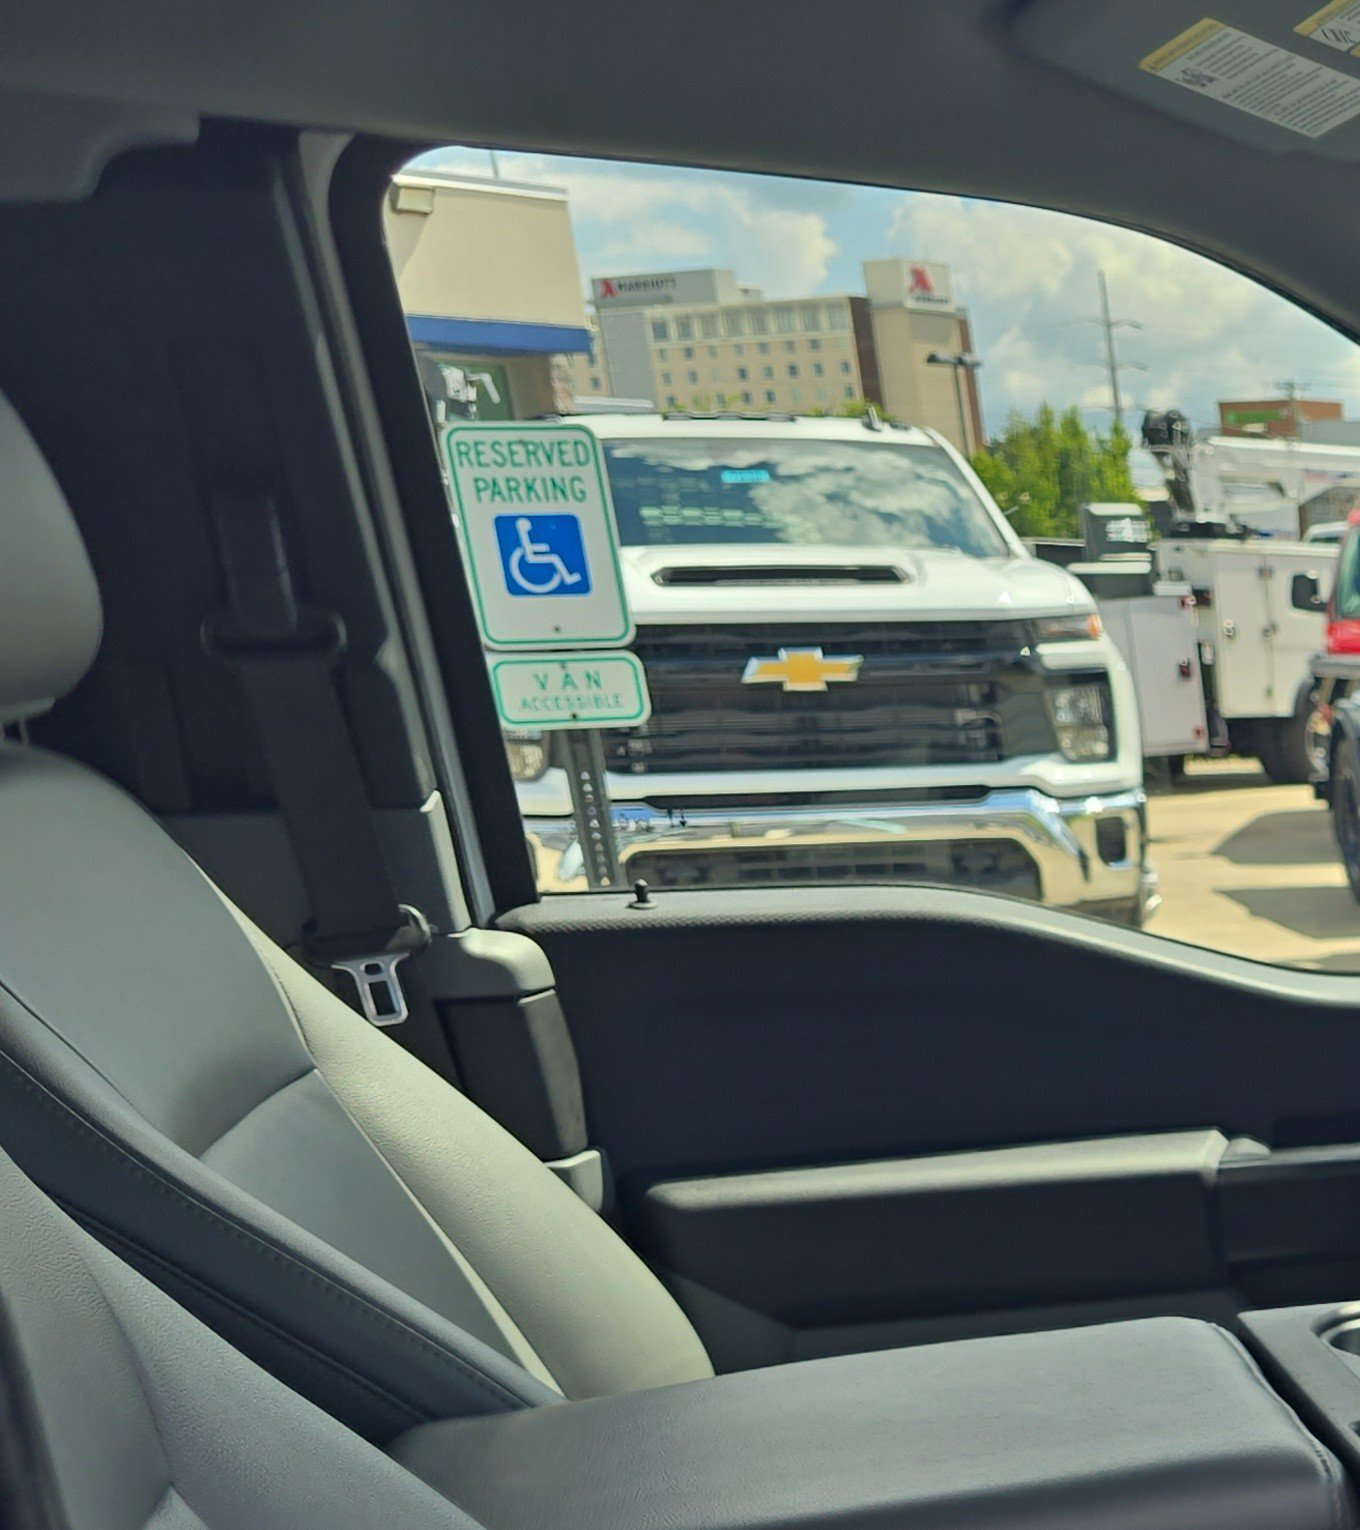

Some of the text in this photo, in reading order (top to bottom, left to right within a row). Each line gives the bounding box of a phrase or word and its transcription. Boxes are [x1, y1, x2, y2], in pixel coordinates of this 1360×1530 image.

[455, 438, 592, 468] RESERVED
[472, 475, 588, 503] PARKING
[532, 670, 603, 691] VAN
[518, 692, 625, 711] ACCESSIBLE
